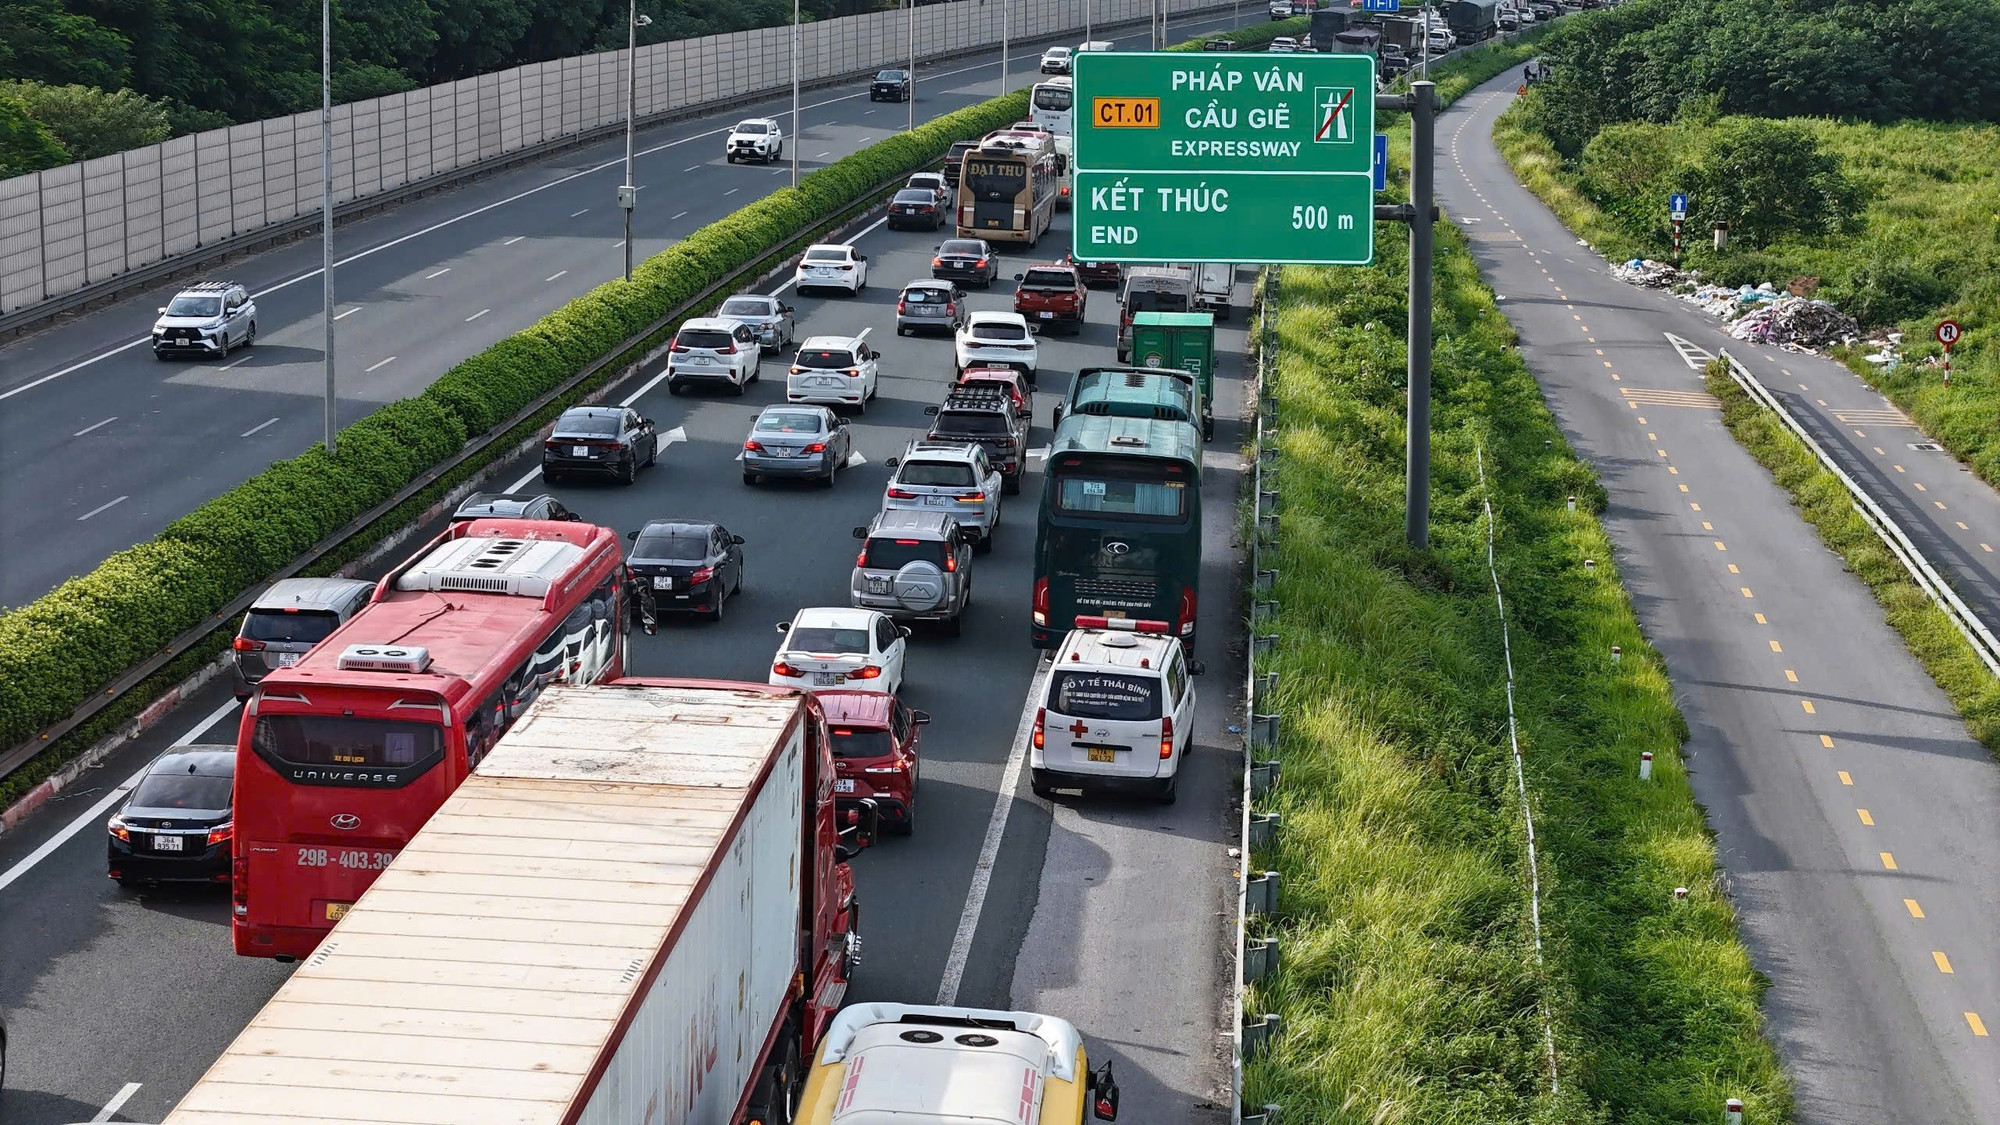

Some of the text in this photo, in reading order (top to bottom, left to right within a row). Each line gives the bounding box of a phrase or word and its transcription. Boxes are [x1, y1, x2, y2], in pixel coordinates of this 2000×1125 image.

[1172, 62, 1303, 92] PHÁP VÂN
[1100, 103, 1153, 123] CT.01
[1185, 99, 1290, 129] CẦU GIẼ
[1172, 141, 1301, 157] EXPRESSWAY
[970, 163, 994, 178] ĐẠI
[1092, 177, 1229, 213] KẾT THÚC
[1292, 206, 1354, 230] 500 m
[1092, 226, 1138, 245] END
[1078, 679, 1085, 687] Y
[1088, 676, 1101, 687] TẾ
[1102, 679, 1125, 689] THÁI
[1126, 684, 1151, 697] BÌNH
[351, 756, 365, 764] LỊCH
[293, 769, 398, 783] UNIVERSE
[162, 836, 175, 844] 36A
[297, 848, 327, 867] 29B
